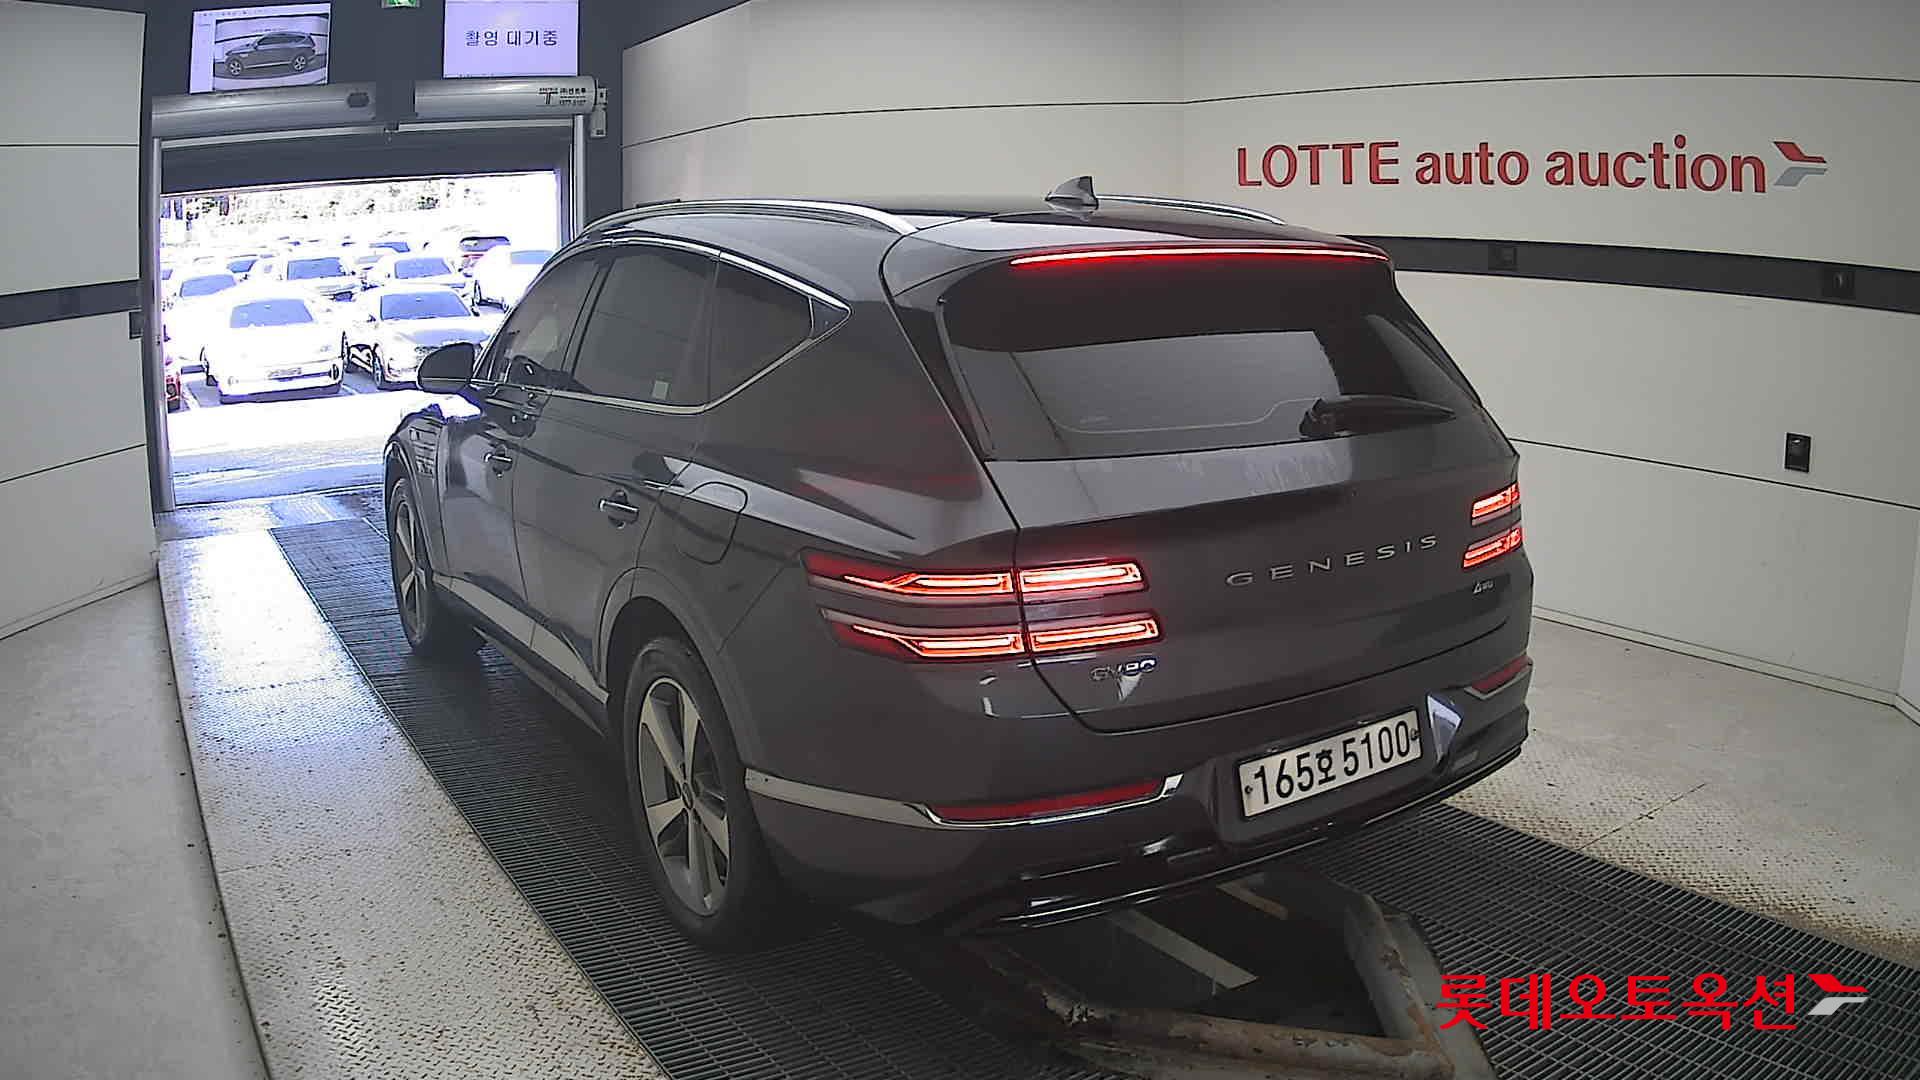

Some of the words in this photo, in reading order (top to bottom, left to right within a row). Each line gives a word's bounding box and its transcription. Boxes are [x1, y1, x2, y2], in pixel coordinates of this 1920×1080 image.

[465, 30, 498, 47] 촬영
[506, 30, 558, 47] 대기중
[1237, 141, 1400, 188] LOTTE
[1415, 142, 1530, 186] auto
[1545, 134, 1768, 193] auction
[1225, 534, 1439, 587] GENESIS
[1253, 748, 1337, 805] 165호
[1341, 720, 1412, 778] 5100
